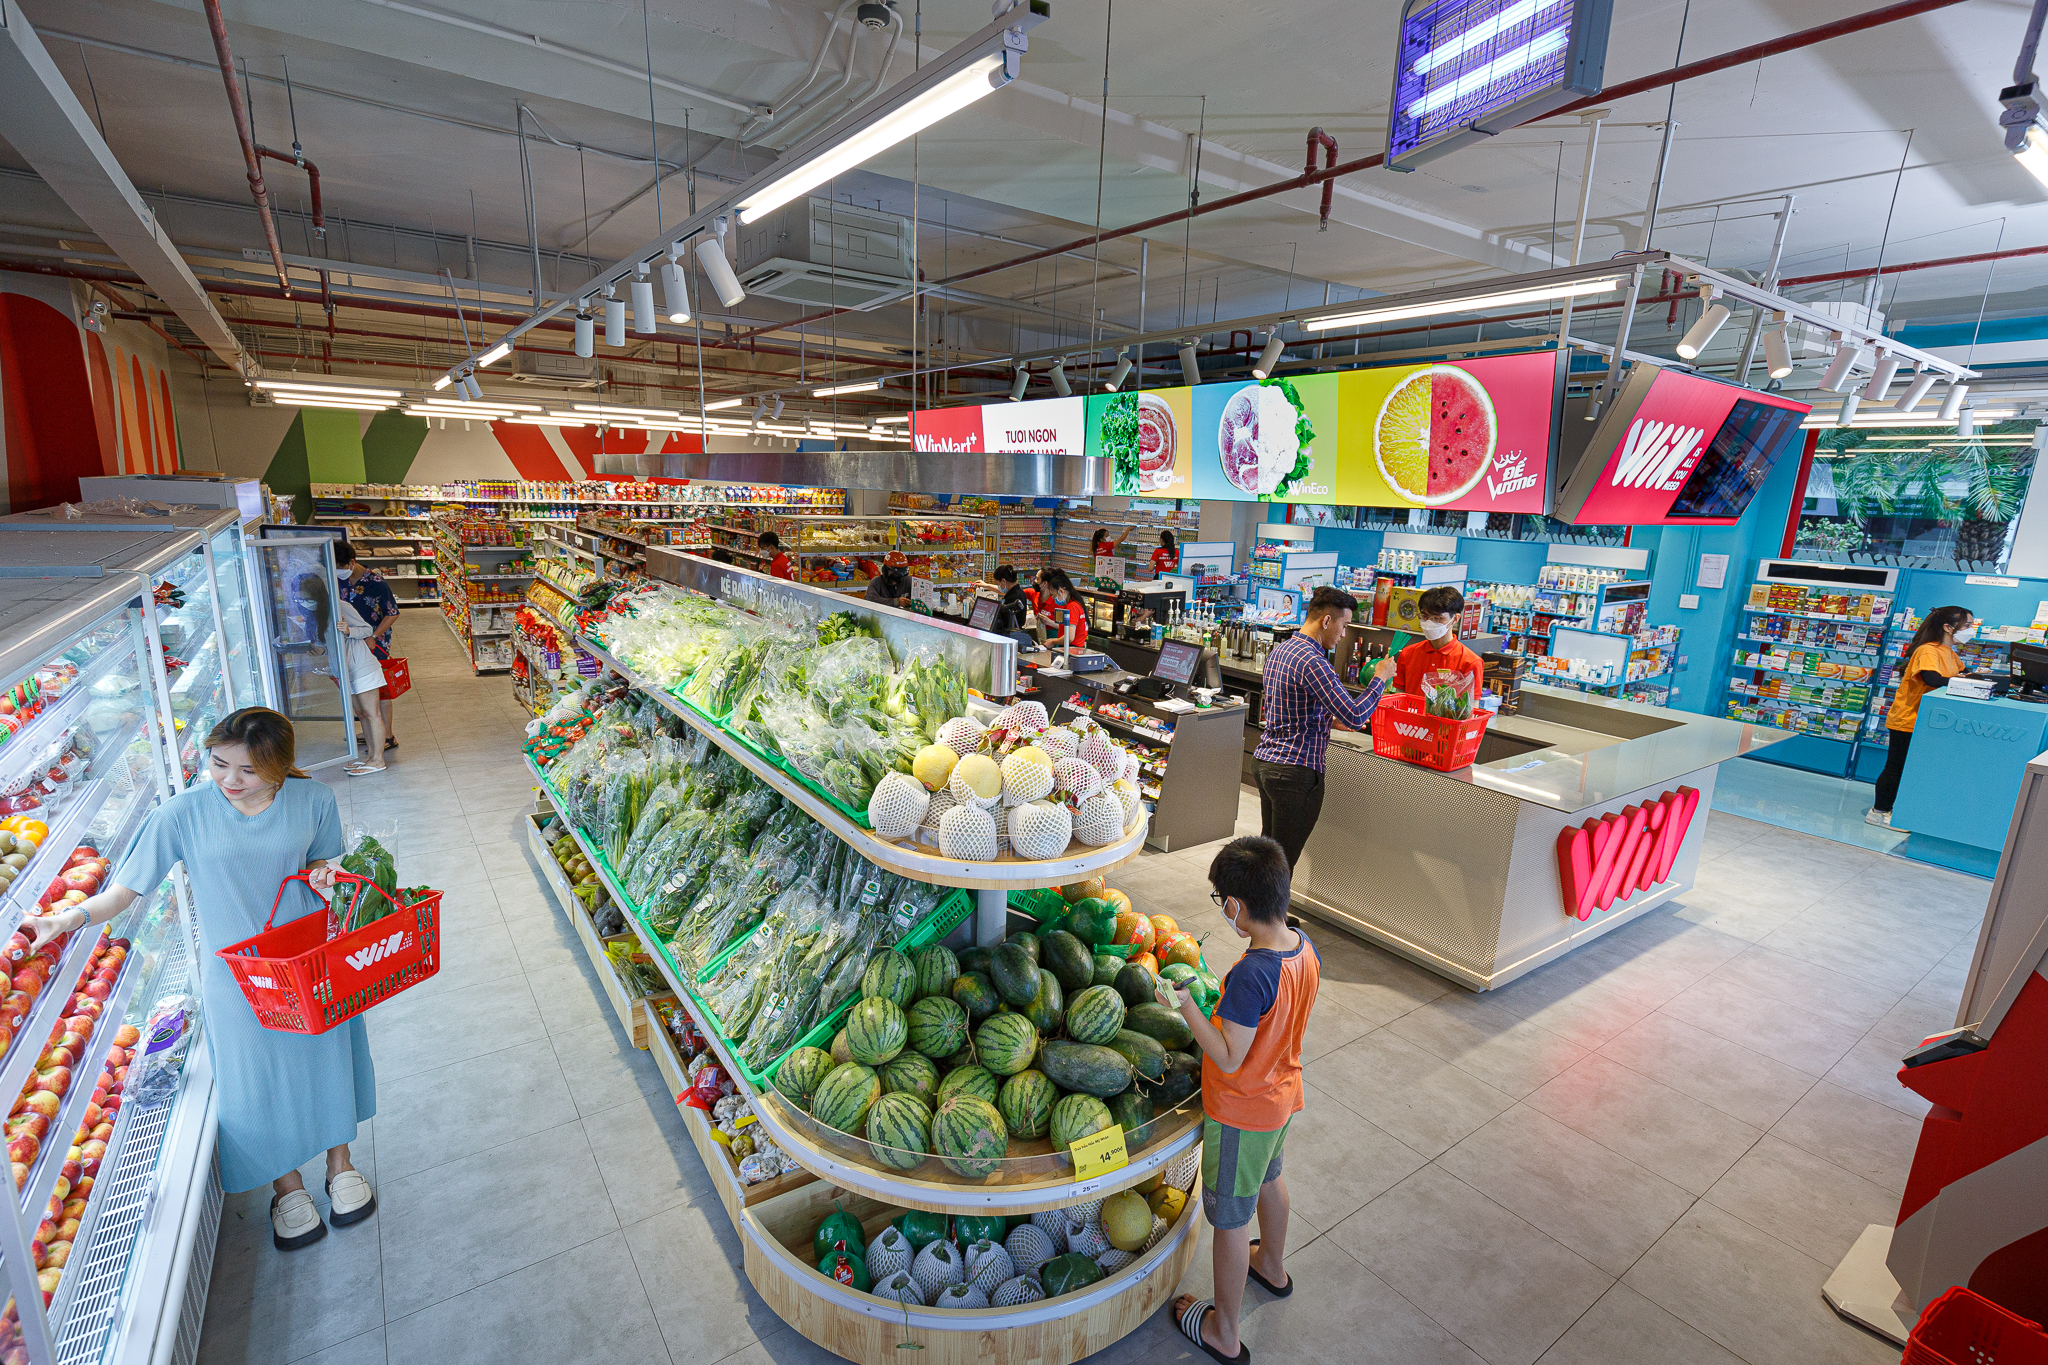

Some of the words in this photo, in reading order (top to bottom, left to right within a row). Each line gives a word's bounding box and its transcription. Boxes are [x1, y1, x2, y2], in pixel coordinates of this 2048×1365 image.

[1028, 428, 1057, 443] NGON
[1681, 458, 1696, 468] ALL
[1672, 470, 1688, 480] YOU
[1287, 479, 1329, 496] WinEco
[1661, 481, 1680, 491] NEED
[732, 580, 750, 601] RAU
